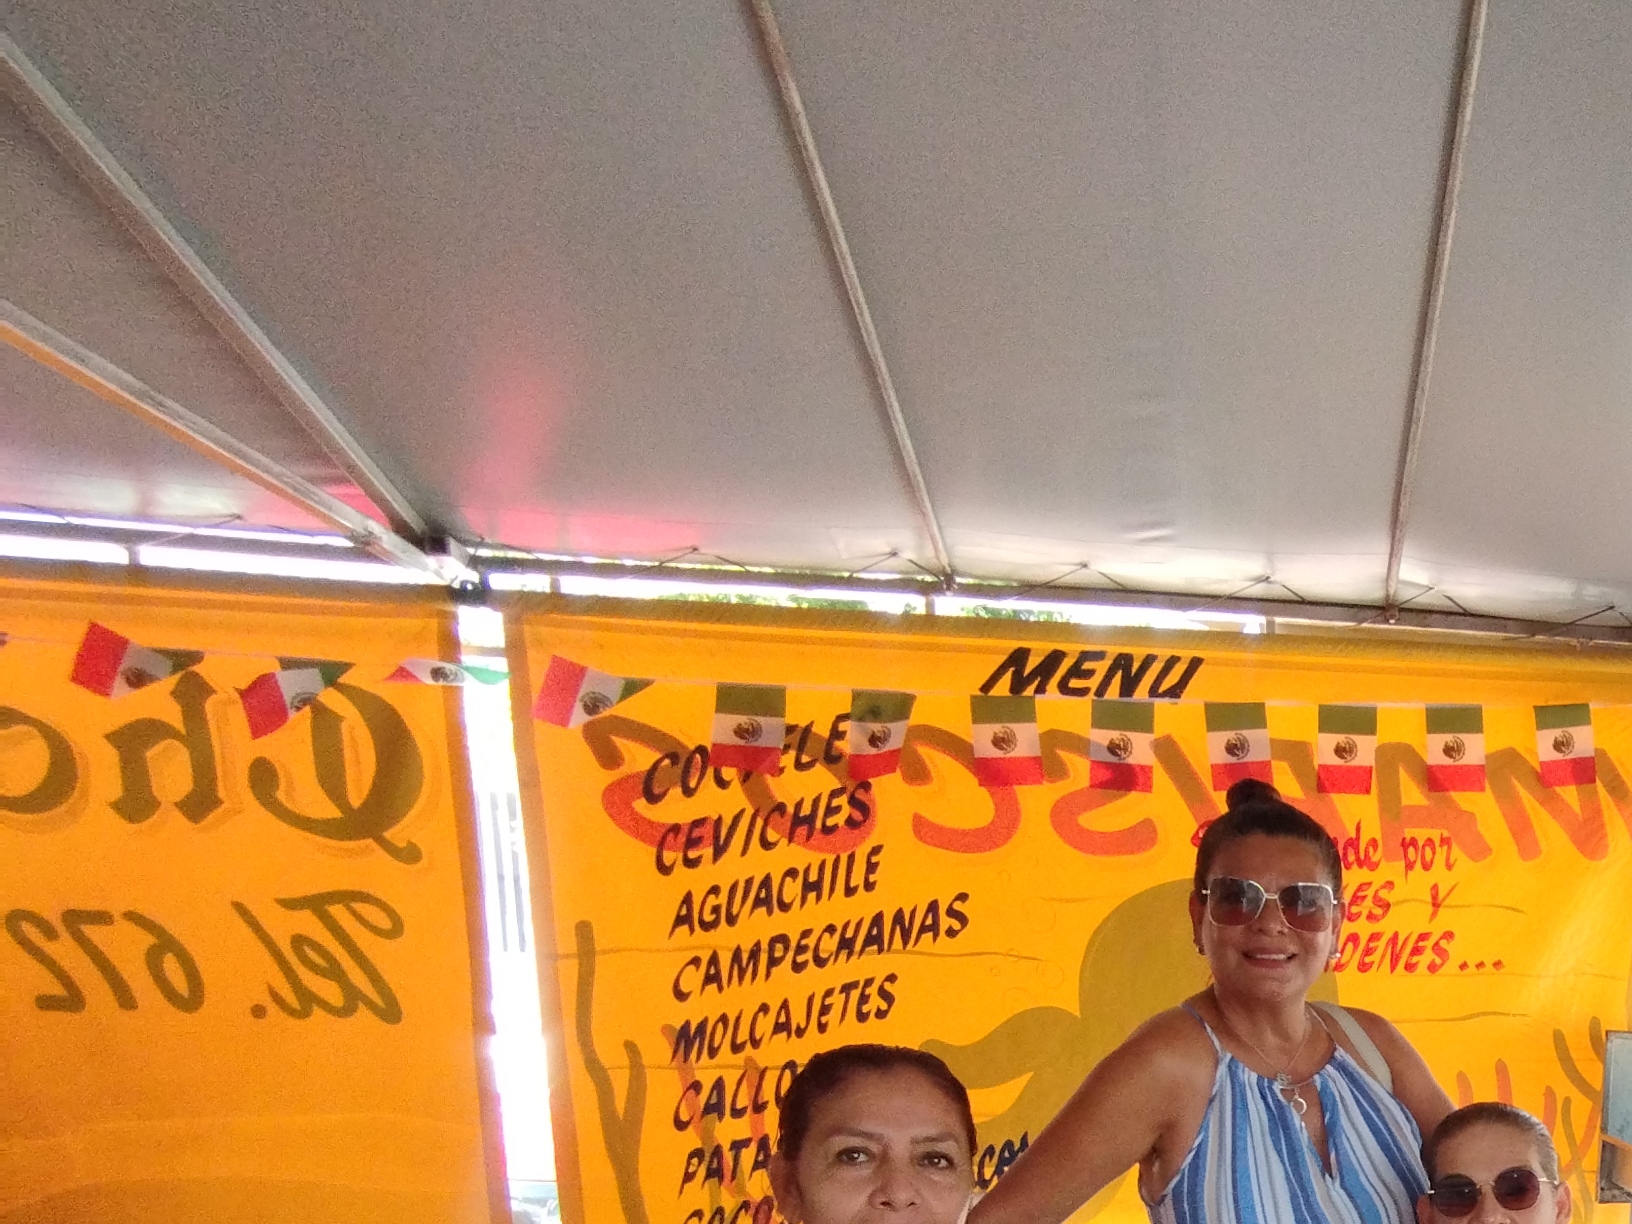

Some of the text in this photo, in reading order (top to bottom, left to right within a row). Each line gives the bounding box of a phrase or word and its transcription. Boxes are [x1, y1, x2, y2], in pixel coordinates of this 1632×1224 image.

[979, 646, 1205, 700] MENU
[655, 779, 873, 877] CEVICHES
[1401, 832, 1458, 885] por
[668, 844, 884, 939] AGUACHILE
[1429, 882, 1460, 924] Y
[672, 891, 970, 1005] CAMPECHANAS
[670, 972, 899, 1065] MOLCAJETES
